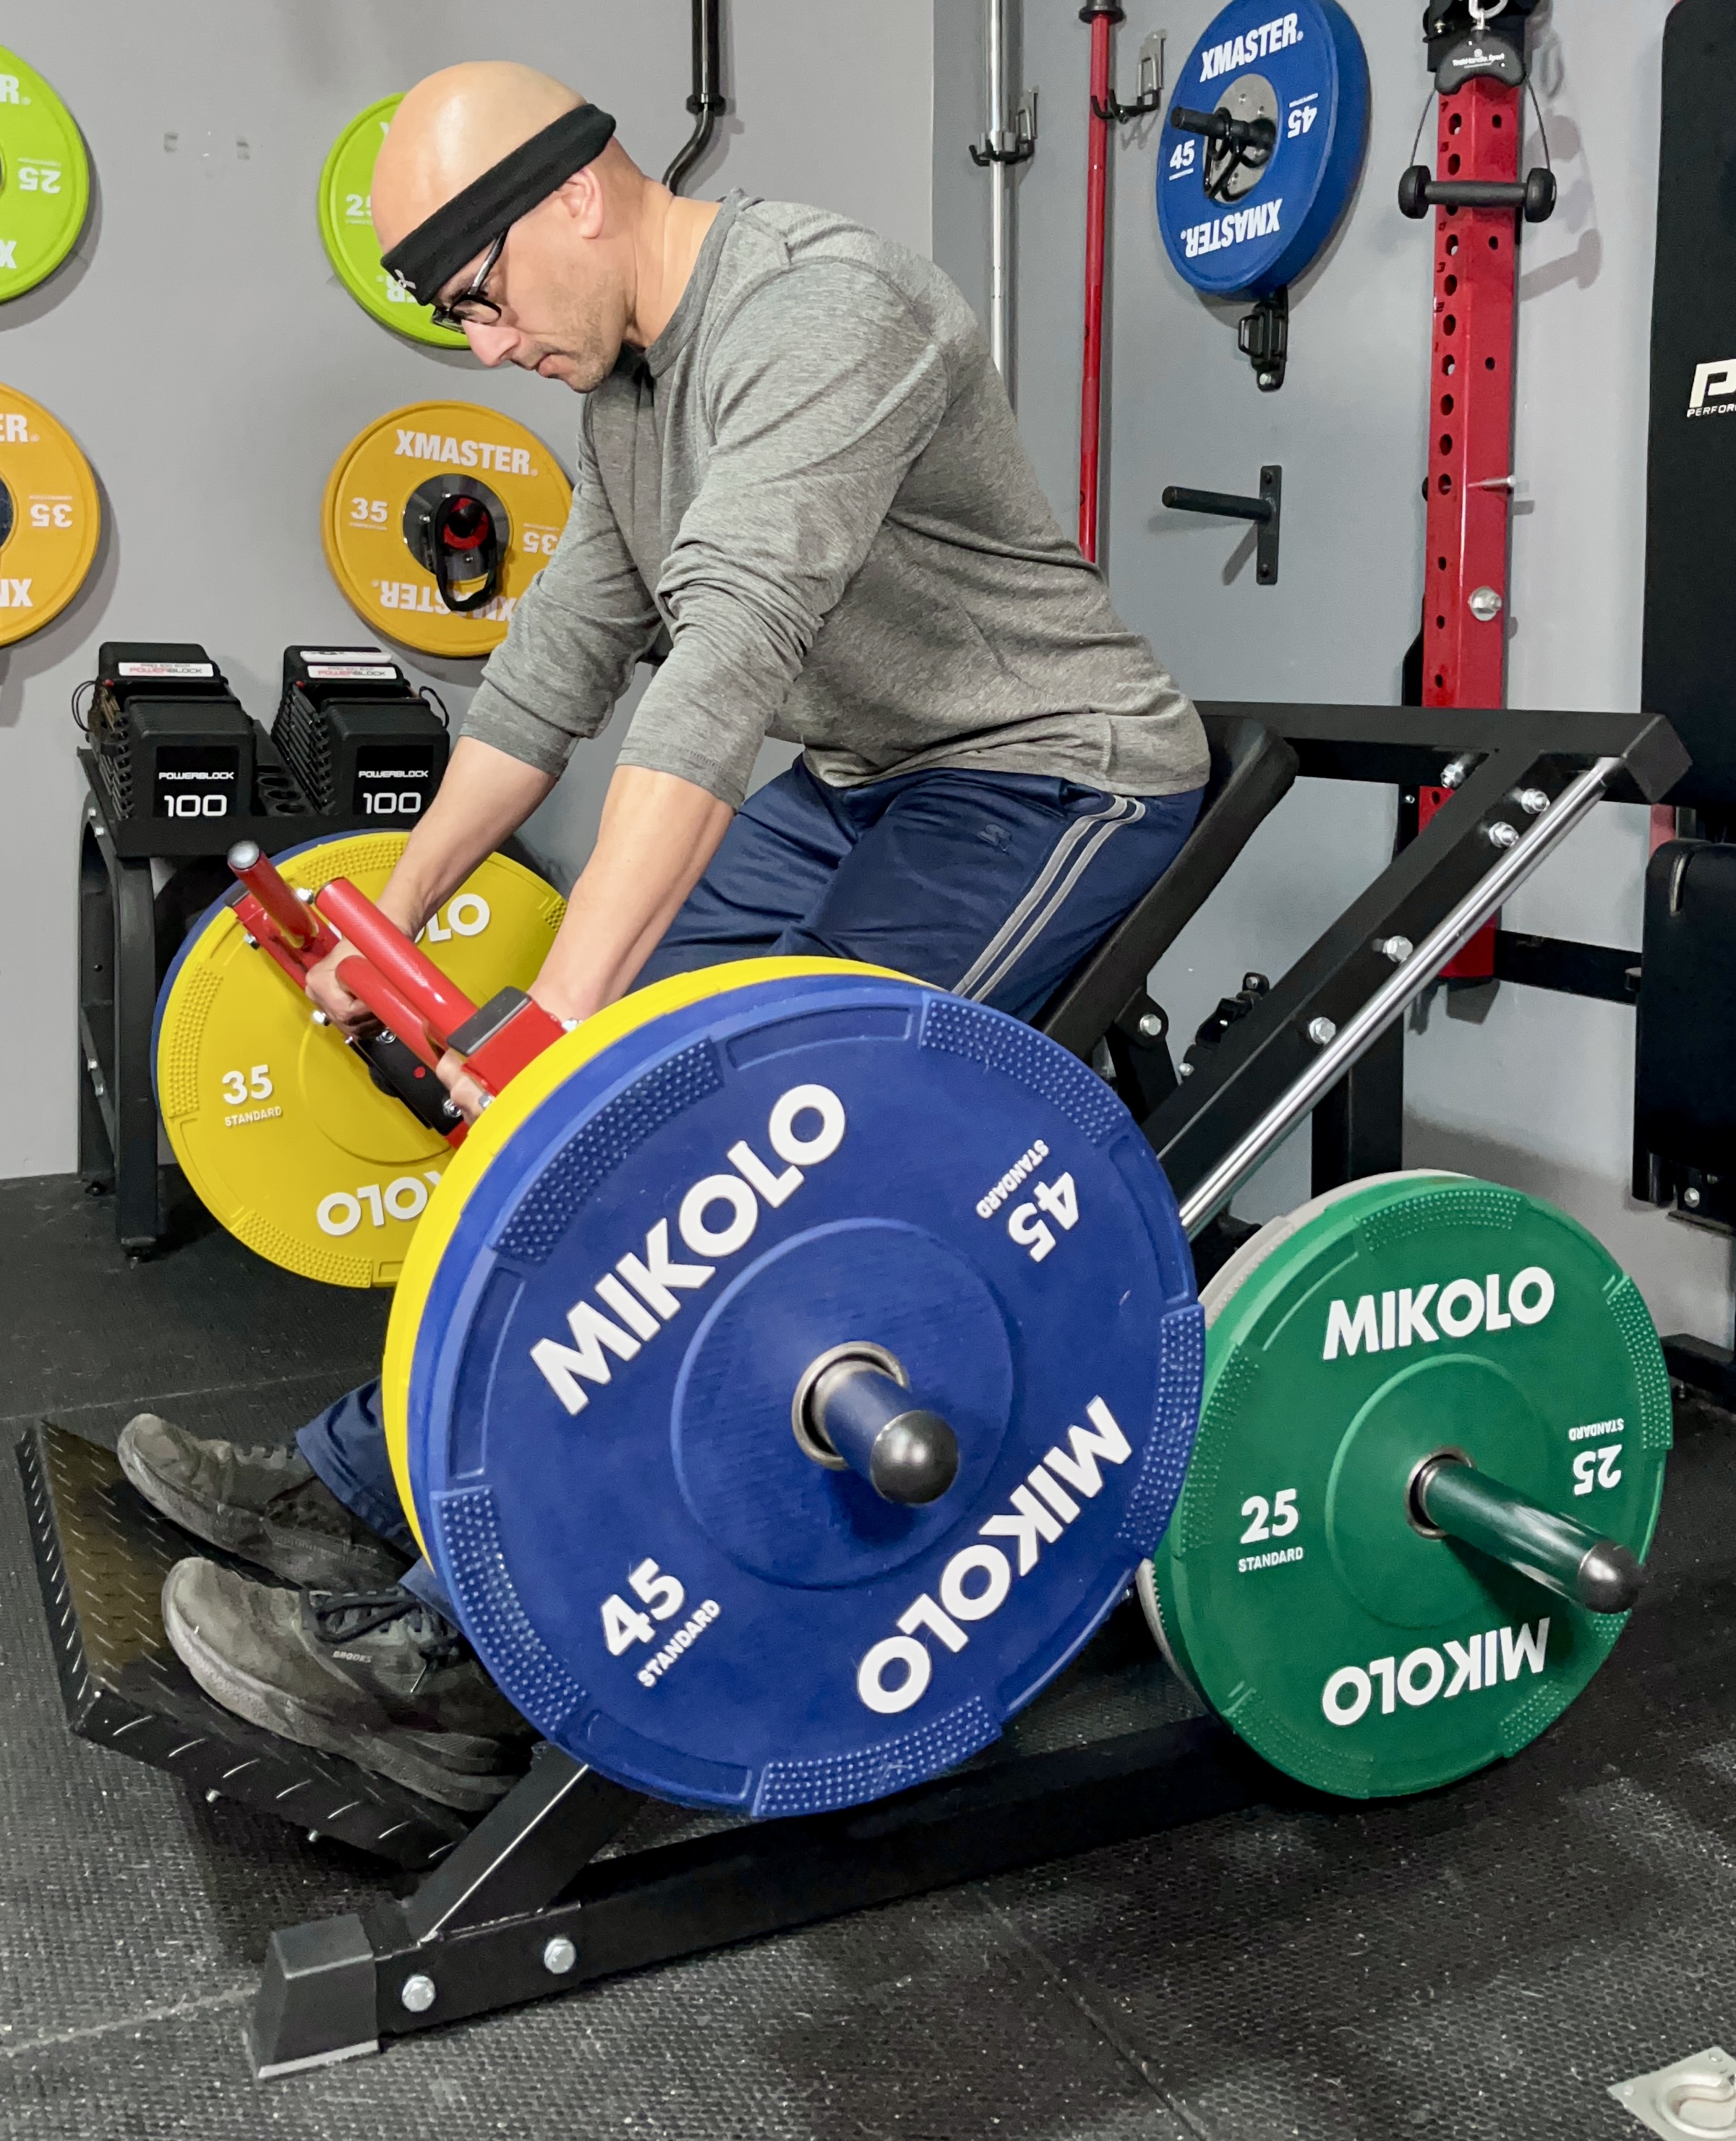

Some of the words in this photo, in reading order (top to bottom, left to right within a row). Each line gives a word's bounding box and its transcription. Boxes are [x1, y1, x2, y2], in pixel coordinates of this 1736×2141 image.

[1287, 106, 1317, 138] 45
[1169, 140, 1195, 169] 45
[18, 166, 61, 194] 25
[346, 194, 372, 217] 2
[1686, 403, 1736, 418] PERFOR
[30, 503, 73, 529] 35
[351, 497, 388, 523] 35
[523, 531, 558, 556] 35
[158, 772, 235, 780] POWERBLOCK
[359, 770, 429, 779] POWERBLOCK
[163, 795, 228, 818] 100
[363, 792, 422, 815] 100
[222, 1064, 273, 1105] 35
[224, 1106, 283, 1127] STANDARD
[976, 1140, 1049, 1219] STANDARD
[1009, 1172, 1079, 1262] 45
[530, 1083, 846, 1416] MIKOLO
[1323, 1265, 1555, 1361] MIKOLO
[1568, 1418, 1625, 1441] STANDARD
[1573, 1444, 1622, 1496] 25
[1240, 1488, 1299, 1544] 25
[857, 1396, 1133, 1715] MIKOLO
[1238, 1546, 1304, 1573] STANDARD
[601, 1557, 685, 1657] 45
[333, 1651, 372, 1663] BROOKS
[636, 1599, 722, 1688] STANDARD
[1322, 1617, 1551, 1727] MIKOLO
